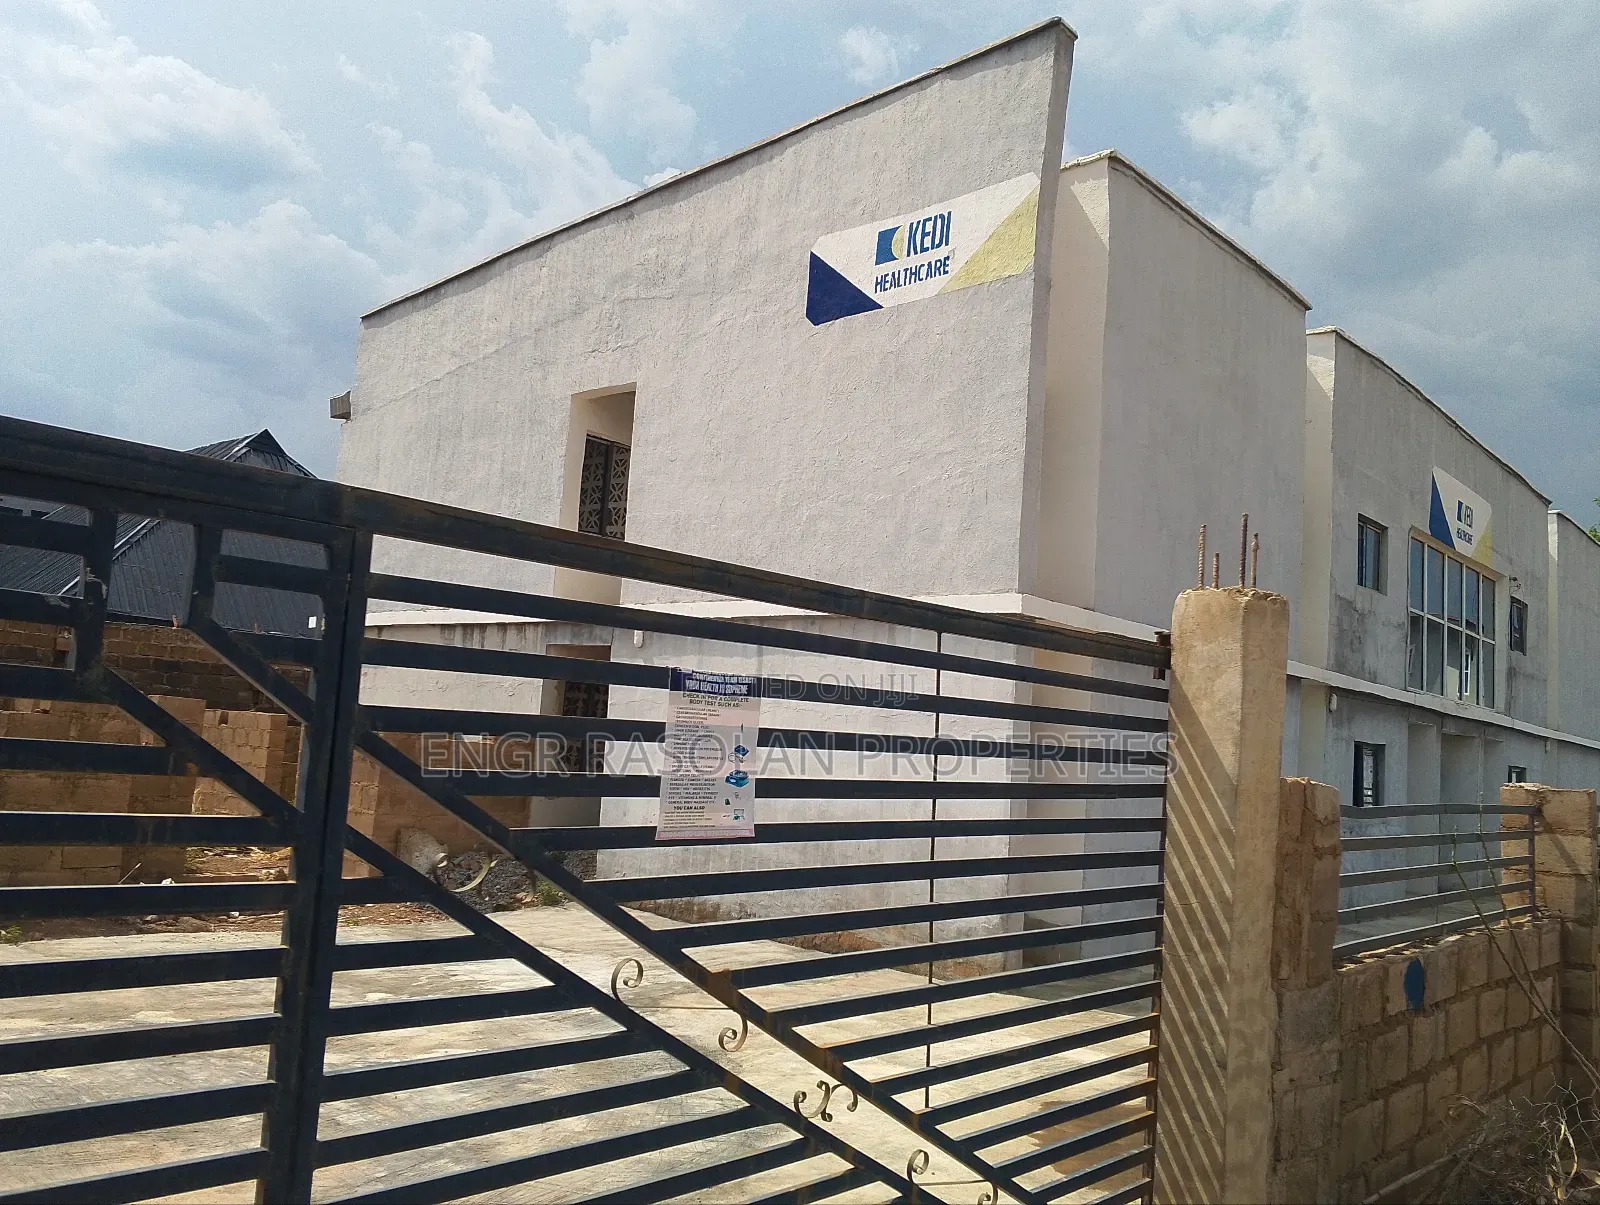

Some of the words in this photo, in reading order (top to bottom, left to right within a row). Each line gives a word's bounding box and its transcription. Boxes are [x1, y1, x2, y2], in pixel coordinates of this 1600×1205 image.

[907, 211, 952, 258] KEDI
[874, 256, 950, 294] HEALTHCARE
[685, 680, 700, 690] YOUR
[700, 681, 718, 693] HEALTH
